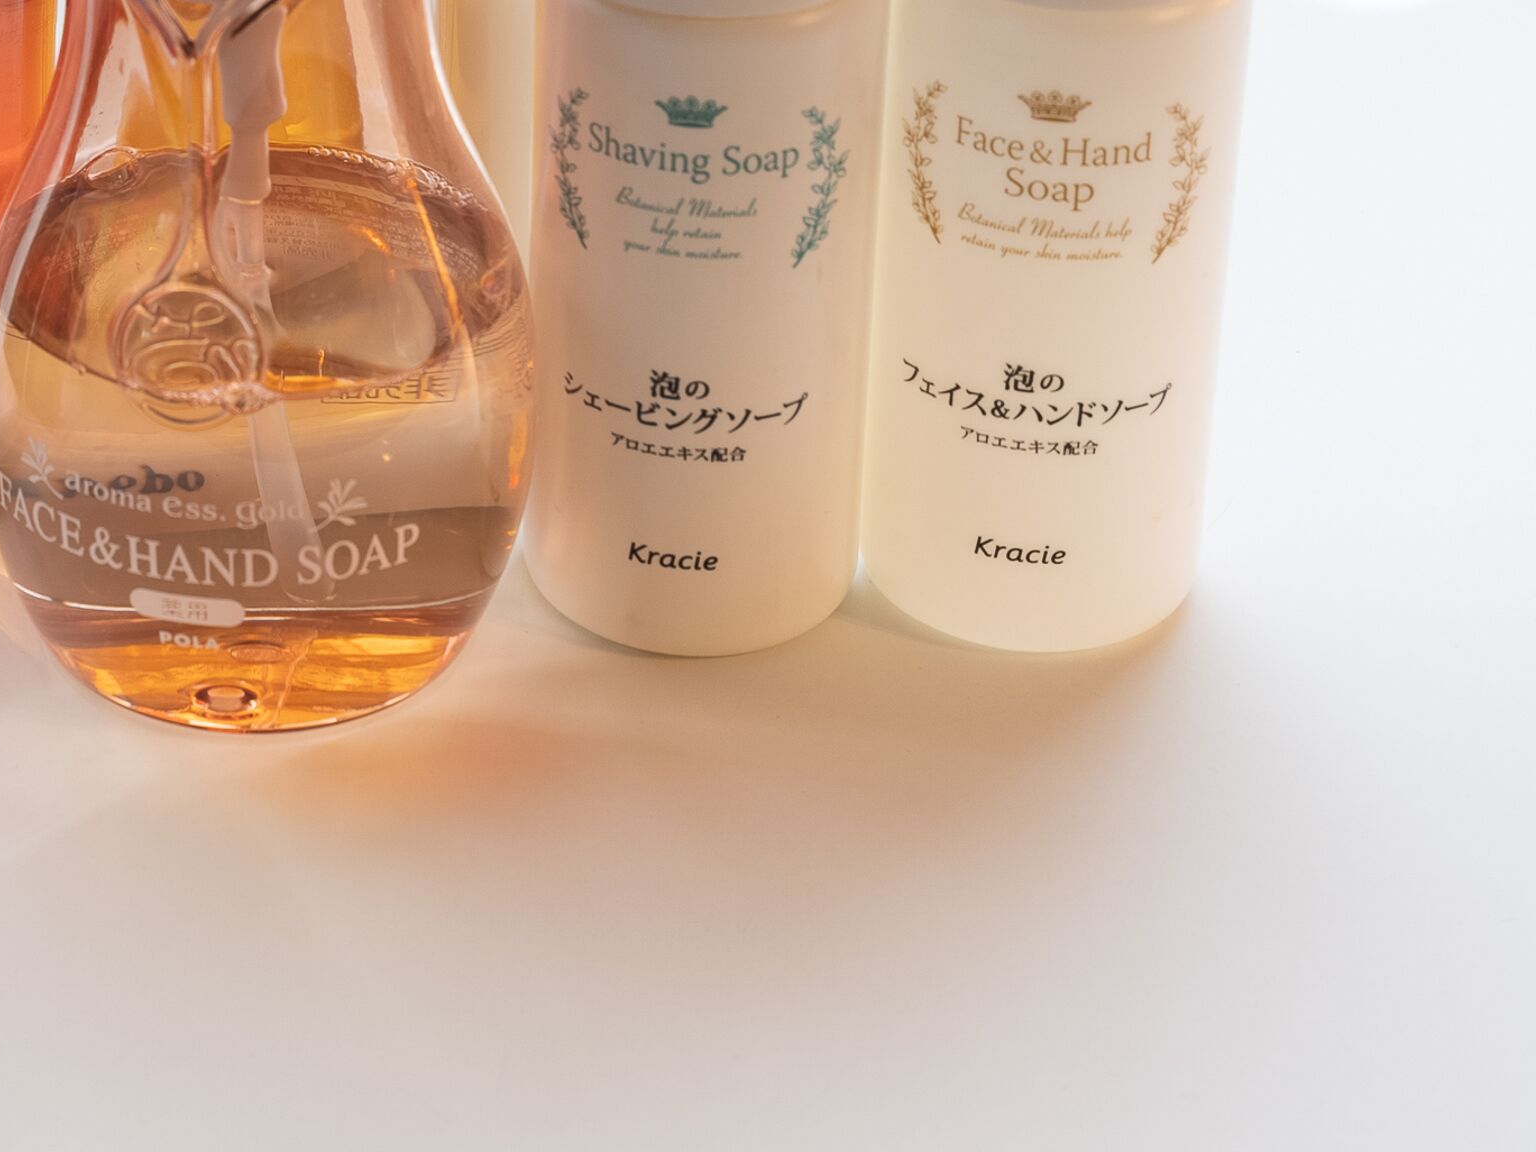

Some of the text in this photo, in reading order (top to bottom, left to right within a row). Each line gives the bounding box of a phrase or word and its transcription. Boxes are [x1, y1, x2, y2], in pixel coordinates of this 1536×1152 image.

[588, 122, 800, 185] Shaving Soap
[616, 186, 757, 219] Botanical Materials
[1004, 167, 1094, 211] Soap
[651, 218, 722, 243] help retain
[957, 202, 1133, 241] Botanical Materials help
[623, 240, 651, 252] your
[960, 234, 996, 251] retain
[1001, 244, 1030, 258] your
[1035, 243, 1061, 260] skin
[650, 369, 710, 401] 泡の
[1004, 362, 1065, 394] 泡の
[563, 370, 809, 435] シェービングソープ
[611, 431, 746, 463] アロエエキス配合
[960, 425, 1099, 456] アロエエキス配合
[64, 470, 306, 529] aroma ess. gold
[296, 523, 421, 586] SOAP
[628, 542, 719, 571] Kracie
[974, 536, 1067, 565] Kracie
[159, 630, 220, 649] POLA
